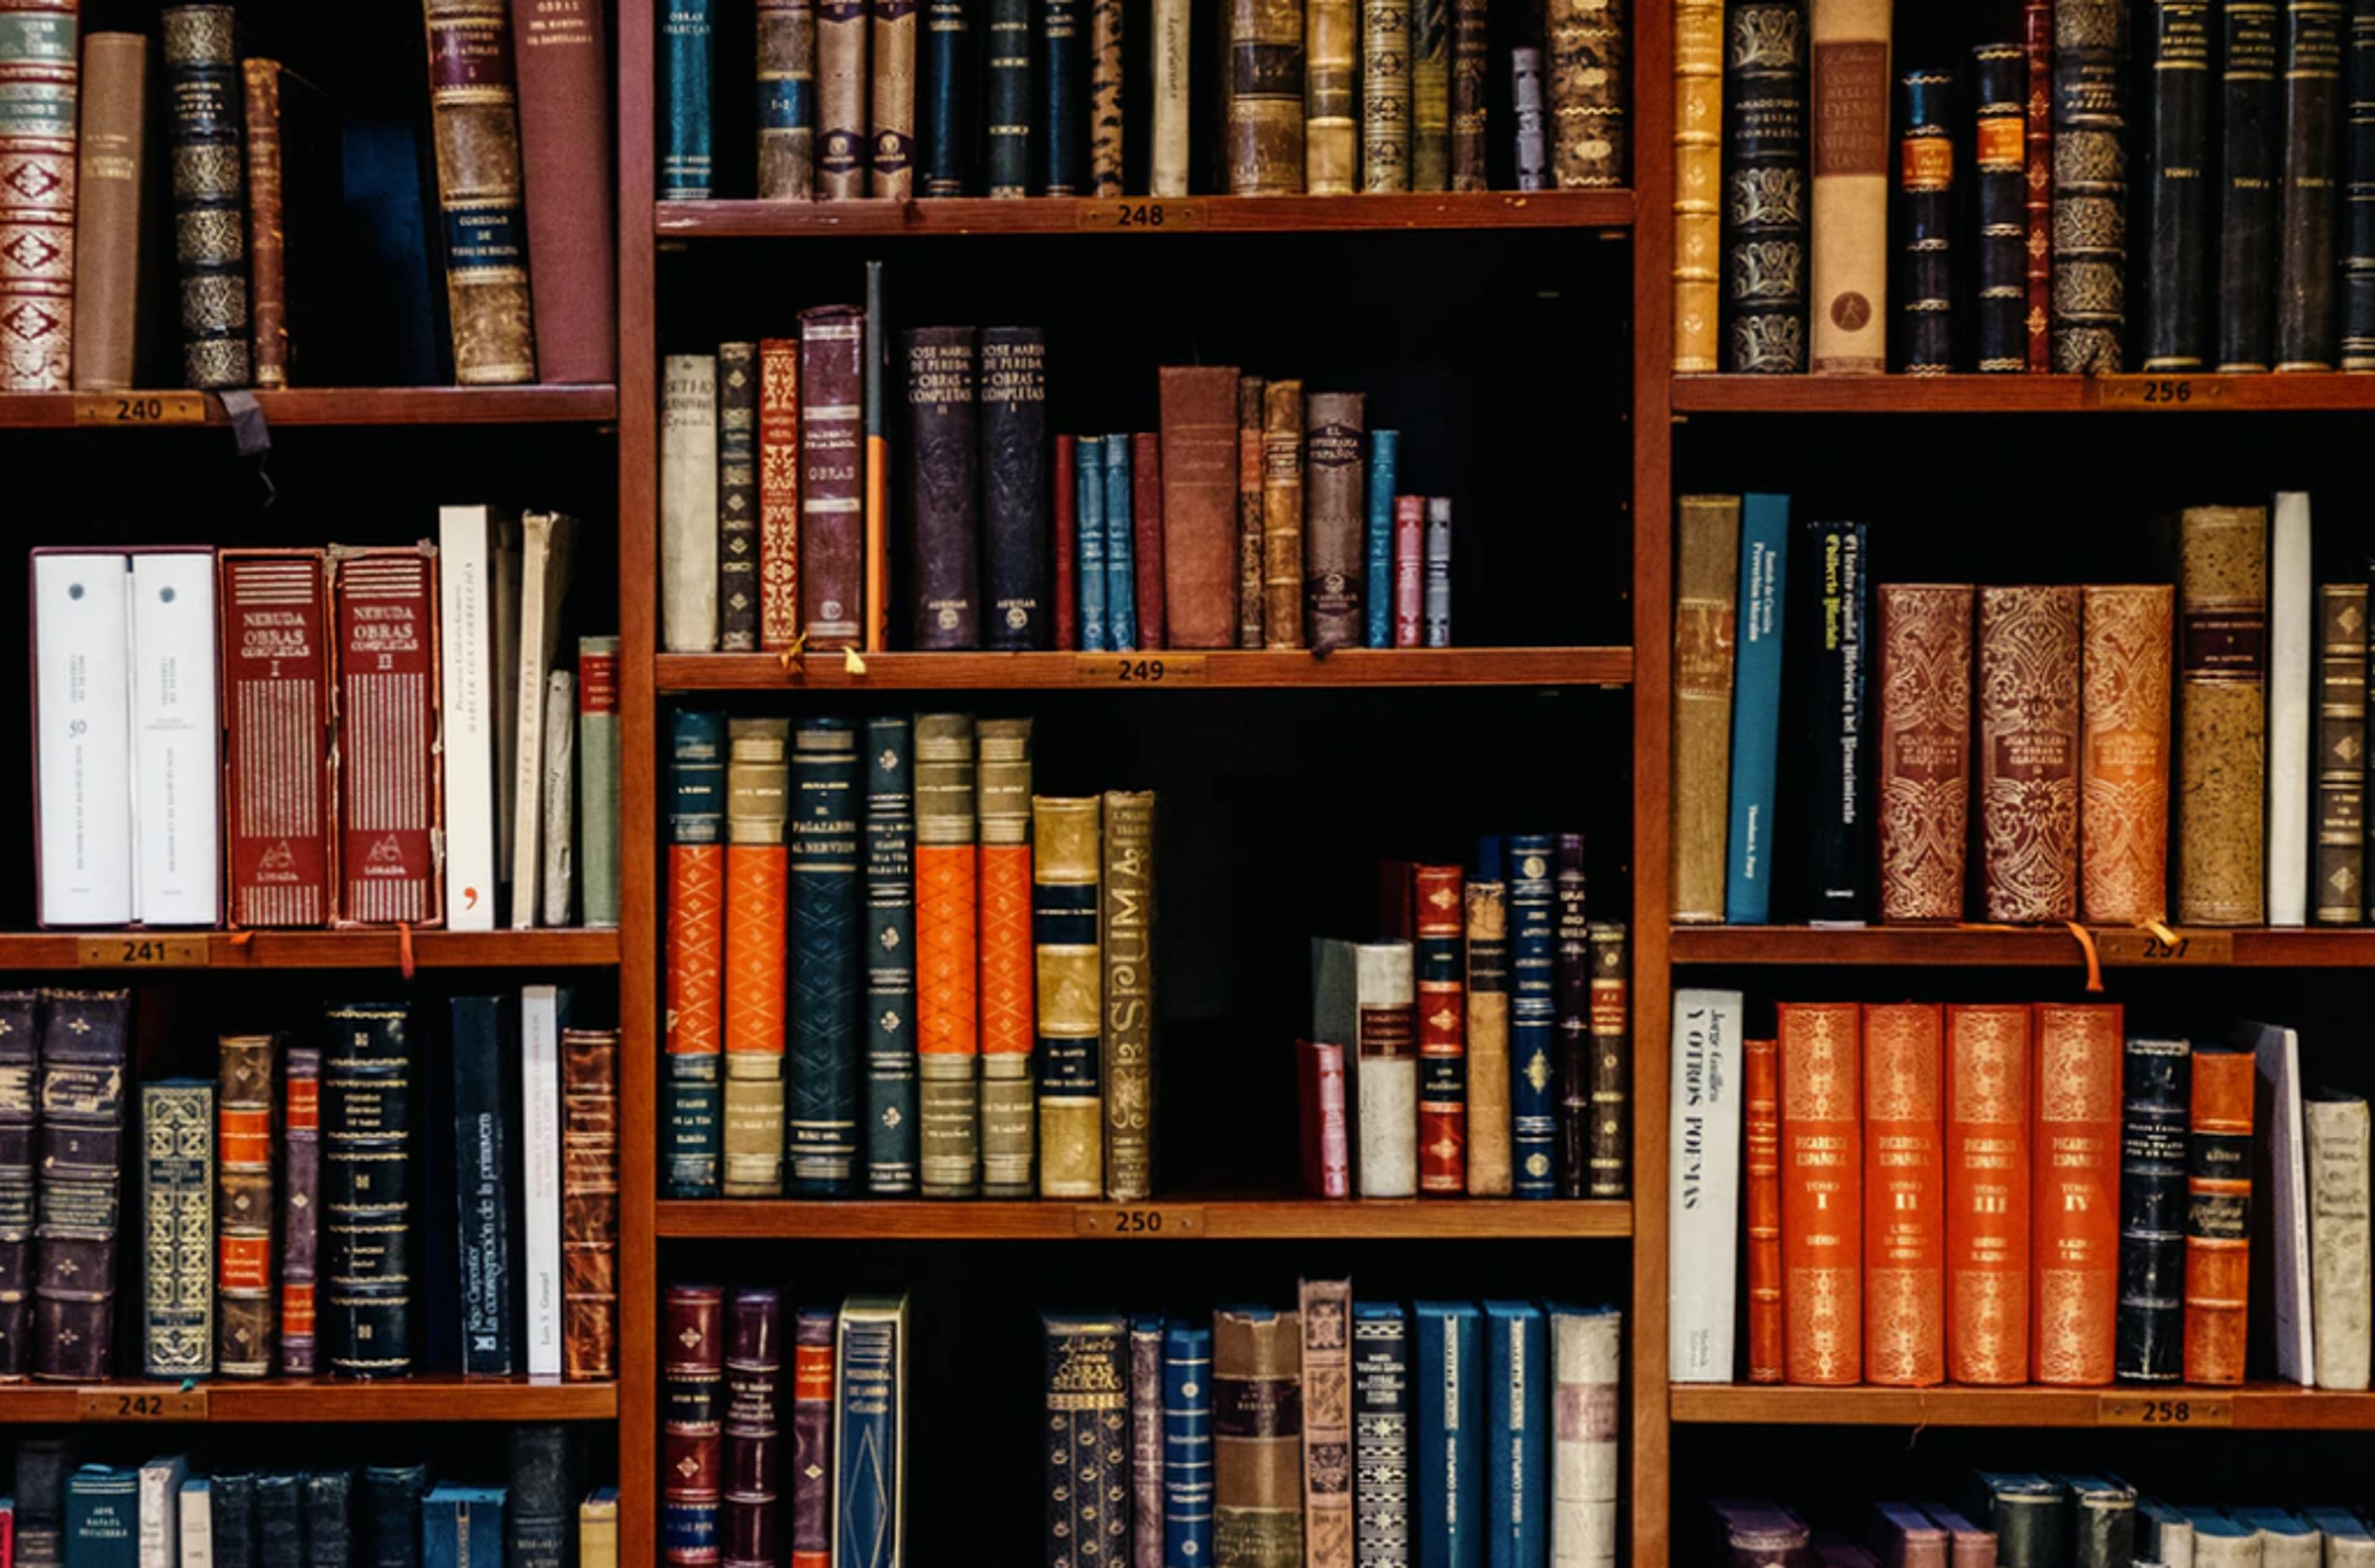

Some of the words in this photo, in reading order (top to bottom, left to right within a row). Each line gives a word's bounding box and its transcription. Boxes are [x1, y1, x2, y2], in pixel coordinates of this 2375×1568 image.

[536, 2, 580, 12] OBRAS
[1118, 205, 1163, 226] 248
[918, 372, 961, 388] OBRAS
[991, 372, 1033, 386] OBRAS
[909, 387, 972, 402] COMPLETAS
[982, 387, 1045, 401] COMPLETAS
[2144, 382, 2192, 401] 256
[116, 400, 162, 420] 240
[1325, 427, 1342, 436] EL
[808, 466, 855, 481] OBRAS
[243, 612, 306, 626] NERUDA
[353, 606, 415, 620] NERUDA
[244, 630, 304, 645] OBRAS
[354, 623, 413, 638] OBRAS
[241, 645, 310, 658] COMPLETAS
[351, 639, 419, 651] COMPLETAS
[270, 660, 280, 677] I
[377, 653, 393, 670] II
[1118, 660, 1164, 680] 249
[123, 942, 166, 962] 241
[1109, 846, 1149, 1065] ESPUMA
[1687, 1009, 1704, 1021] Y
[1709, 1009, 1726, 1048] Jorge
[1685, 1030, 1704, 1106] OTROS
[1683, 1116, 1704, 1210] POEMAS
[1817, 1193, 1827, 1210] I
[1894, 1193, 1917, 1210] II
[1973, 1196, 2006, 1213] III
[2064, 1195, 2092, 1210] IV
[1116, 1212, 1162, 1232] 250
[1058, 1363, 1115, 1376] OBRAS
[118, 1396, 163, 1415] 242
[2142, 1402, 2189, 1421] 258
